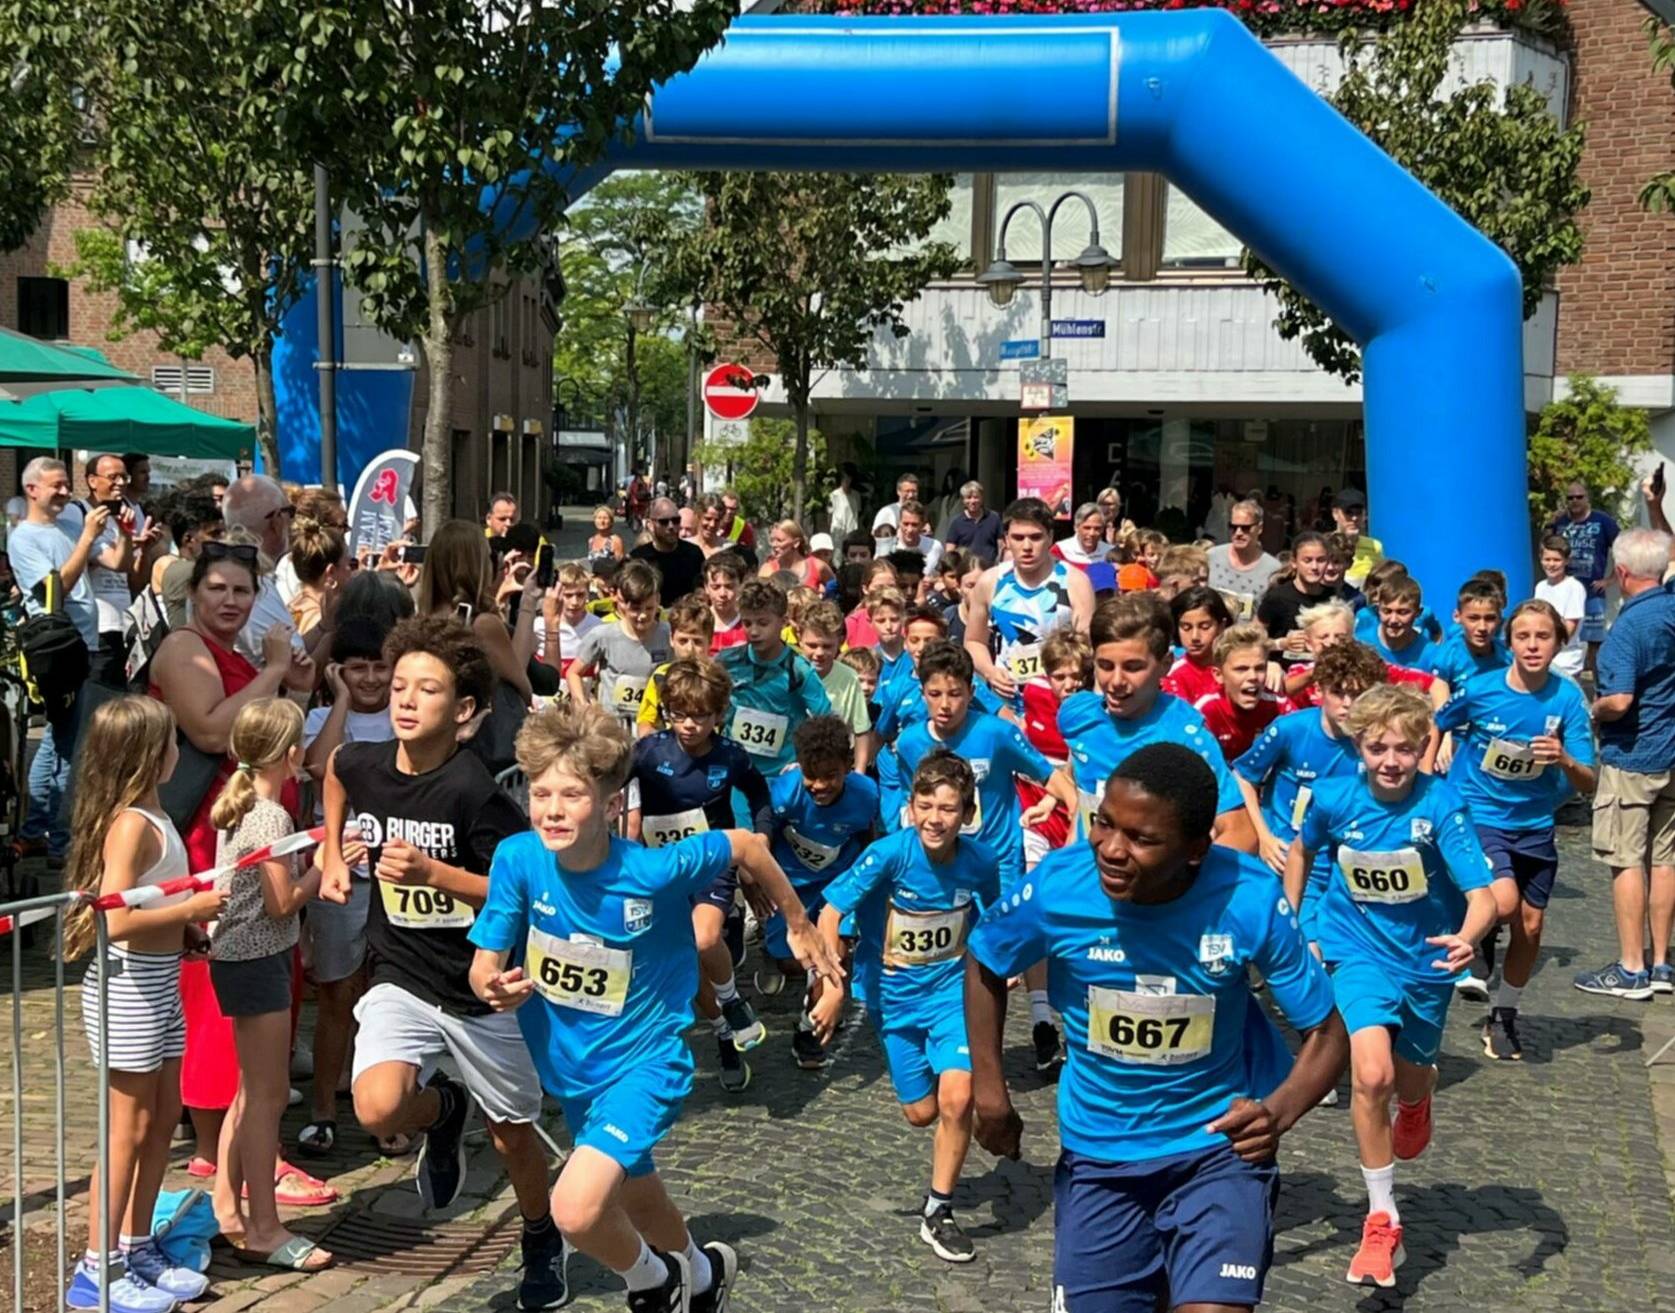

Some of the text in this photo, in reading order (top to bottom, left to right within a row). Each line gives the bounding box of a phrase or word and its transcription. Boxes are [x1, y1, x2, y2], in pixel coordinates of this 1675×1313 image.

[740, 722, 777, 747] 334
[1495, 754, 1536, 774] 661
[386, 817, 456, 848] BURGER
[1353, 868, 1409, 893] 660
[393, 887, 455, 915] 709
[900, 927, 952, 952] 330
[1087, 947, 1126, 962] JAKO
[540, 956, 609, 997] 653
[1109, 1015, 1191, 1049] 667
[1219, 1263, 1257, 1280] JAKO
